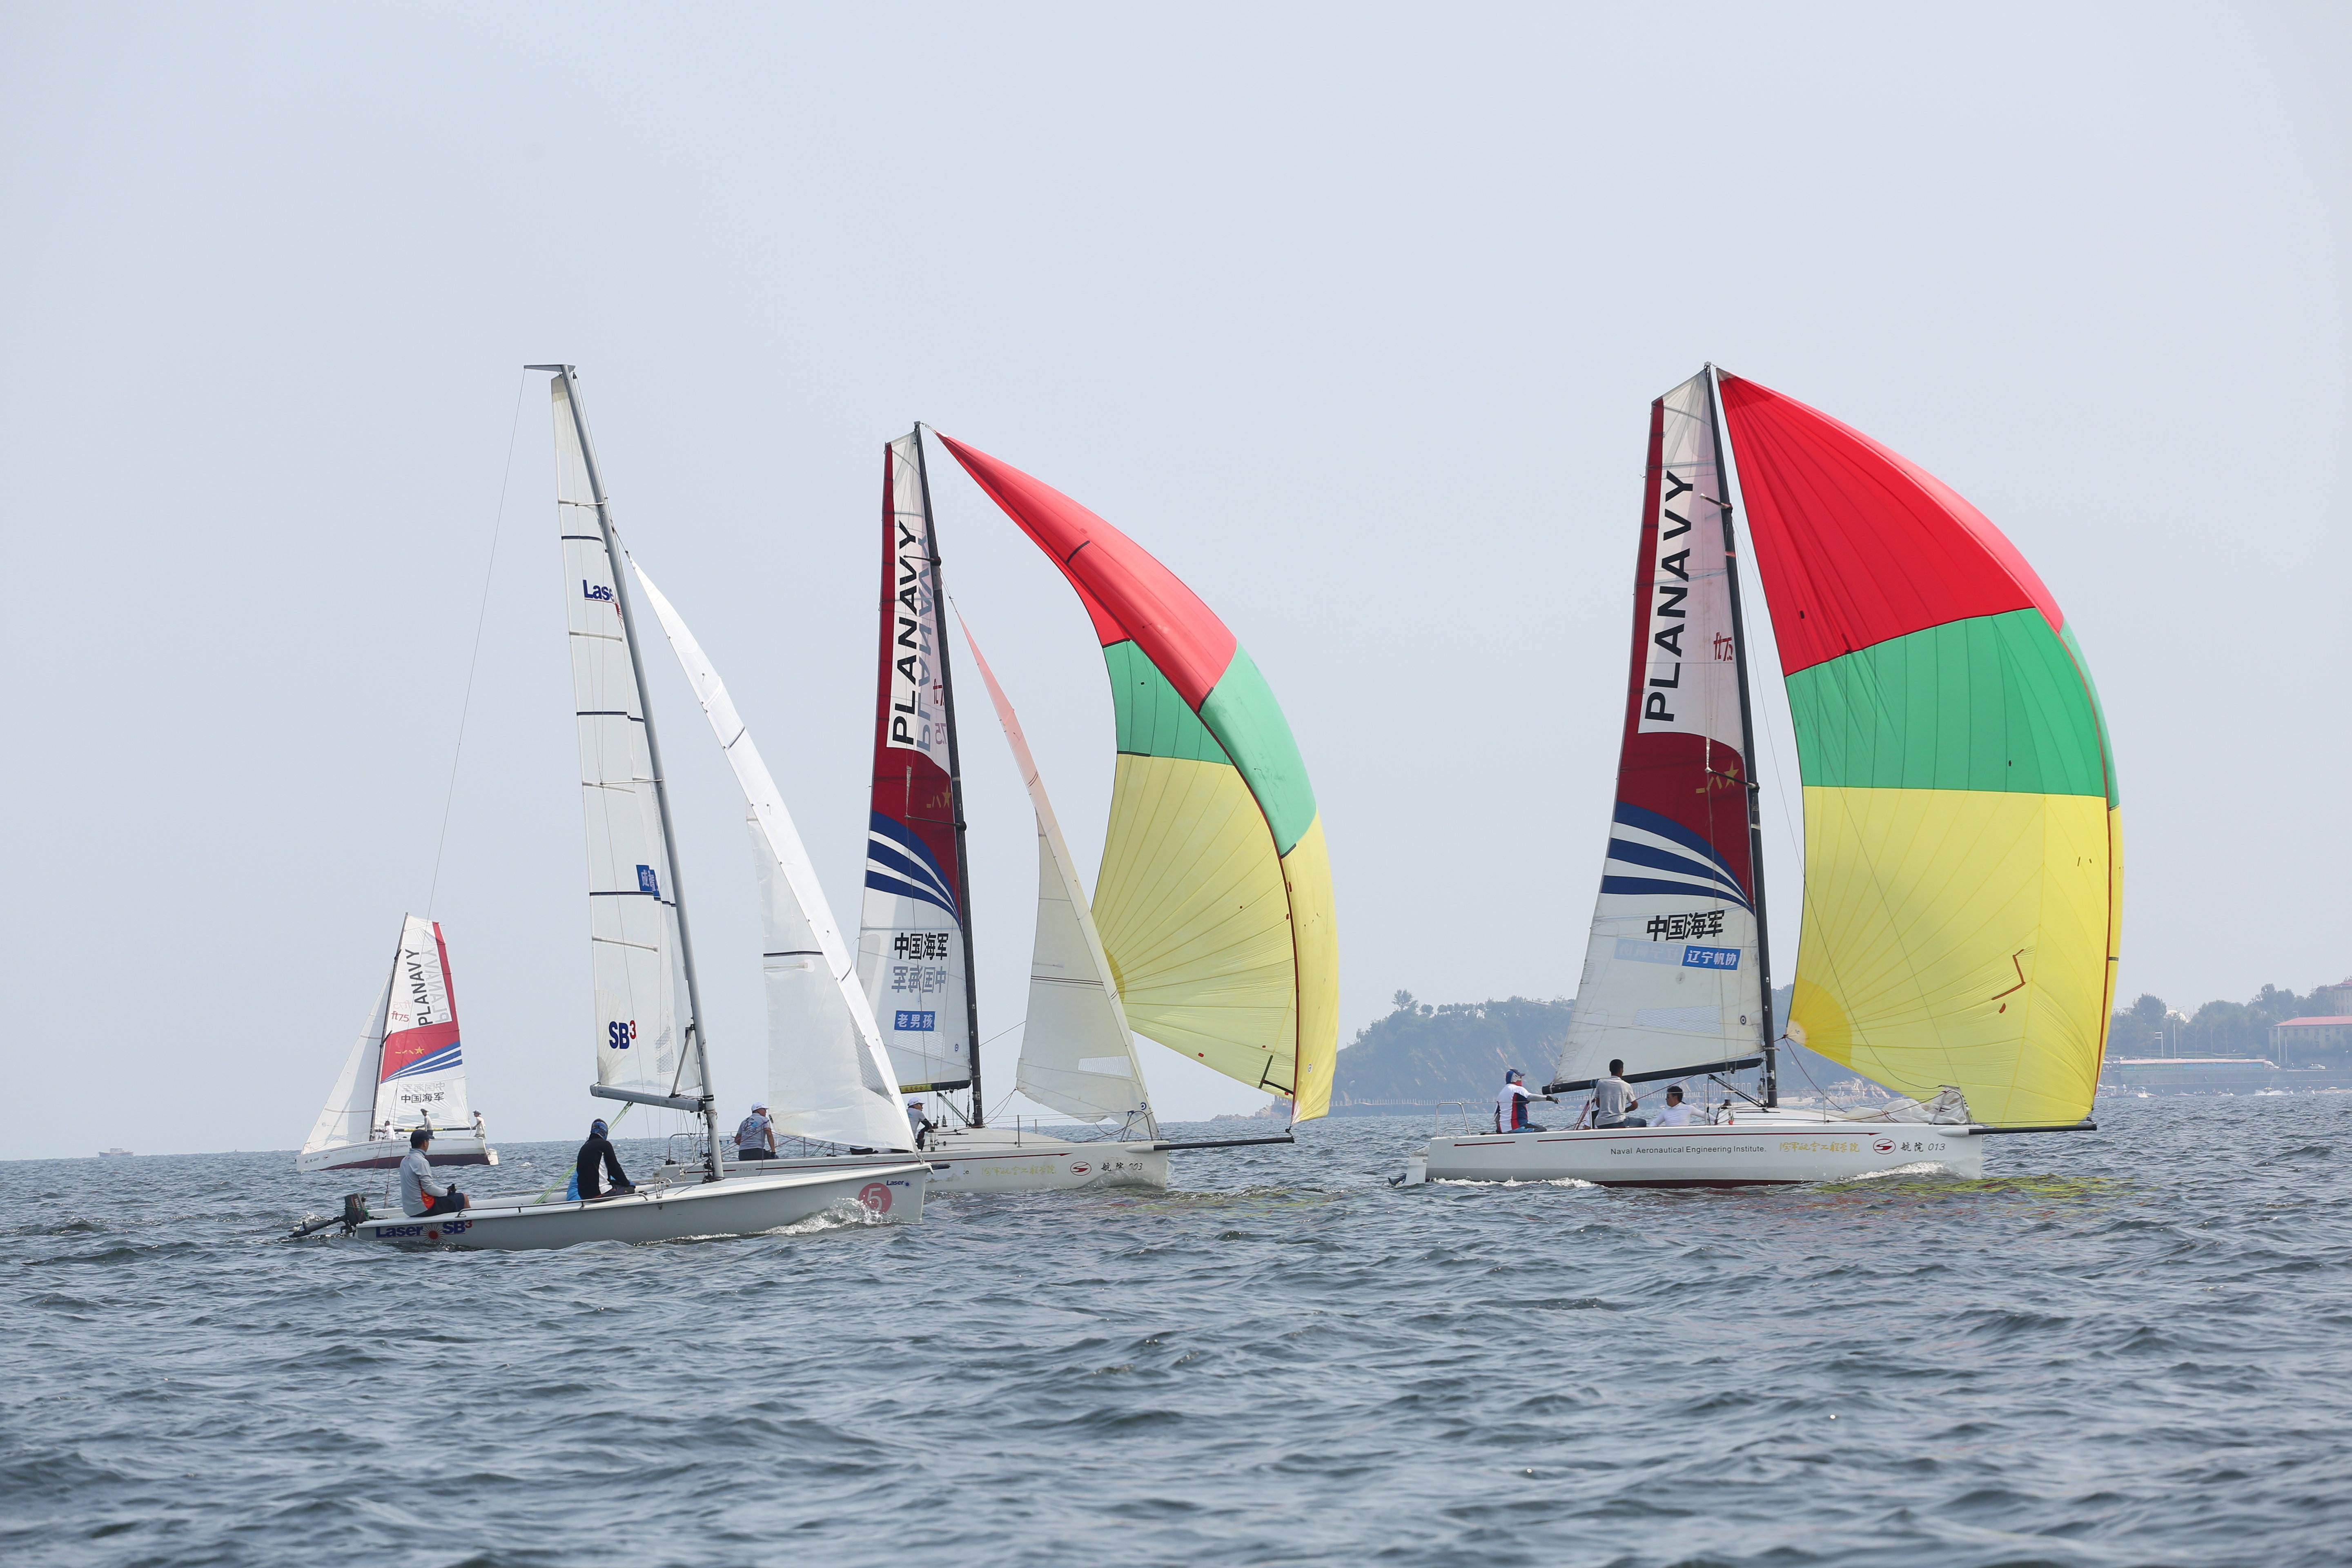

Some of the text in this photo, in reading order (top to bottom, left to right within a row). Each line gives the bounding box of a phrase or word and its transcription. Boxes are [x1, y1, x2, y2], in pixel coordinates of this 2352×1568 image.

[1645, 470, 1693, 722] PLANAVY
[892, 520, 917, 745] PLANAVY
[1646, 910, 1725, 942] 中国海军
[893, 932, 949, 960] 中国海军
[1686, 950, 1736, 966] 辽宁帆协
[405, 949, 433, 1026] PLANAVY
[897, 1012, 934, 1029] 老男孩
[401, 1092, 444, 1103] 中国海军
[1928, 1143, 1945, 1151] 013
[867, 1187, 882, 1210] 5
[376, 1225, 423, 1237] Laser
